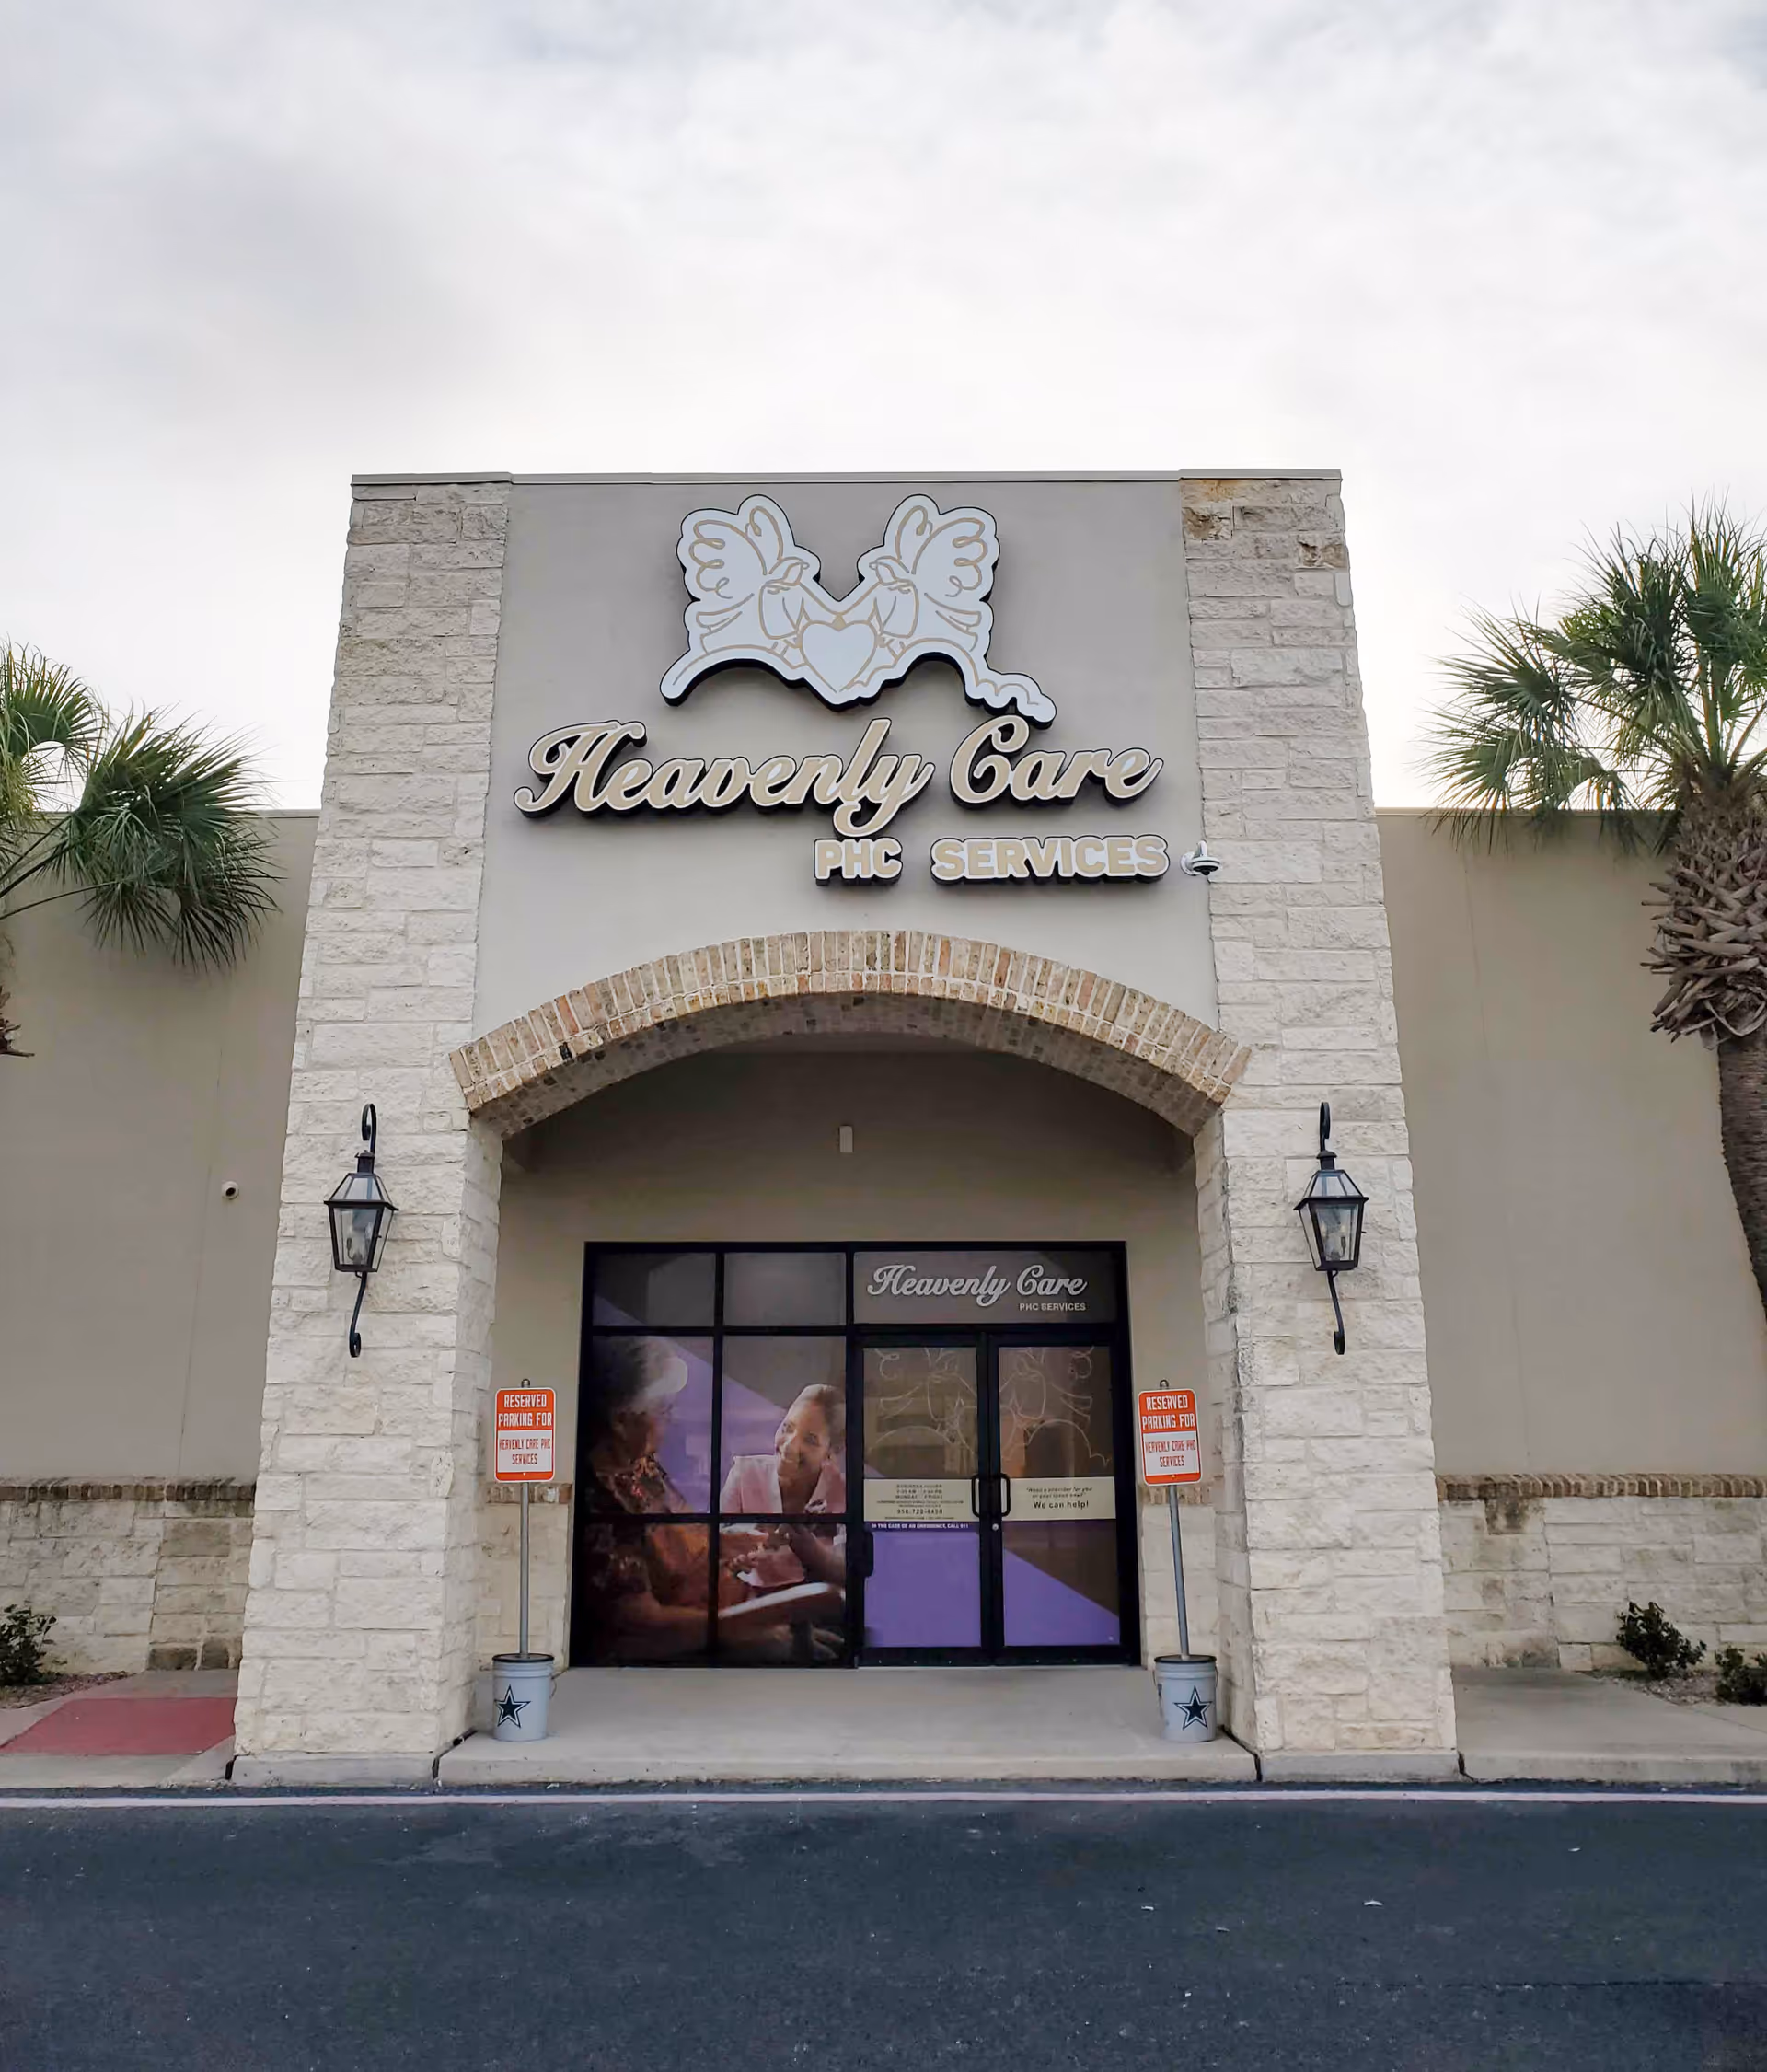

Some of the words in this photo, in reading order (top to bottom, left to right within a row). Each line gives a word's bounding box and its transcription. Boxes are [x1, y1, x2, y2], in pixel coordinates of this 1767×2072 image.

[514, 718, 932, 838] Heavenly
[950, 714, 1165, 806] Care
[814, 838, 903, 883] PHC
[930, 835, 1170, 881] SERVICES
[867, 1264, 1011, 1307] Heavenly
[1016, 1264, 1088, 1296] Care
[1019, 1302, 1039, 1312] PHC
[1041, 1302, 1087, 1312] SERVICES
[503, 1394, 547, 1408] RESERVED
[1146, 1395, 1189, 1411] RESERVED
[498, 1413, 533, 1427] PARKING
[536, 1412, 552, 1426] FOR
[1142, 1414, 1176, 1430] PARKING
[1179, 1413, 1195, 1428] FOR
[512, 1453, 537, 1465] SERVICES
[1068, 1500, 1089, 1511] help!
